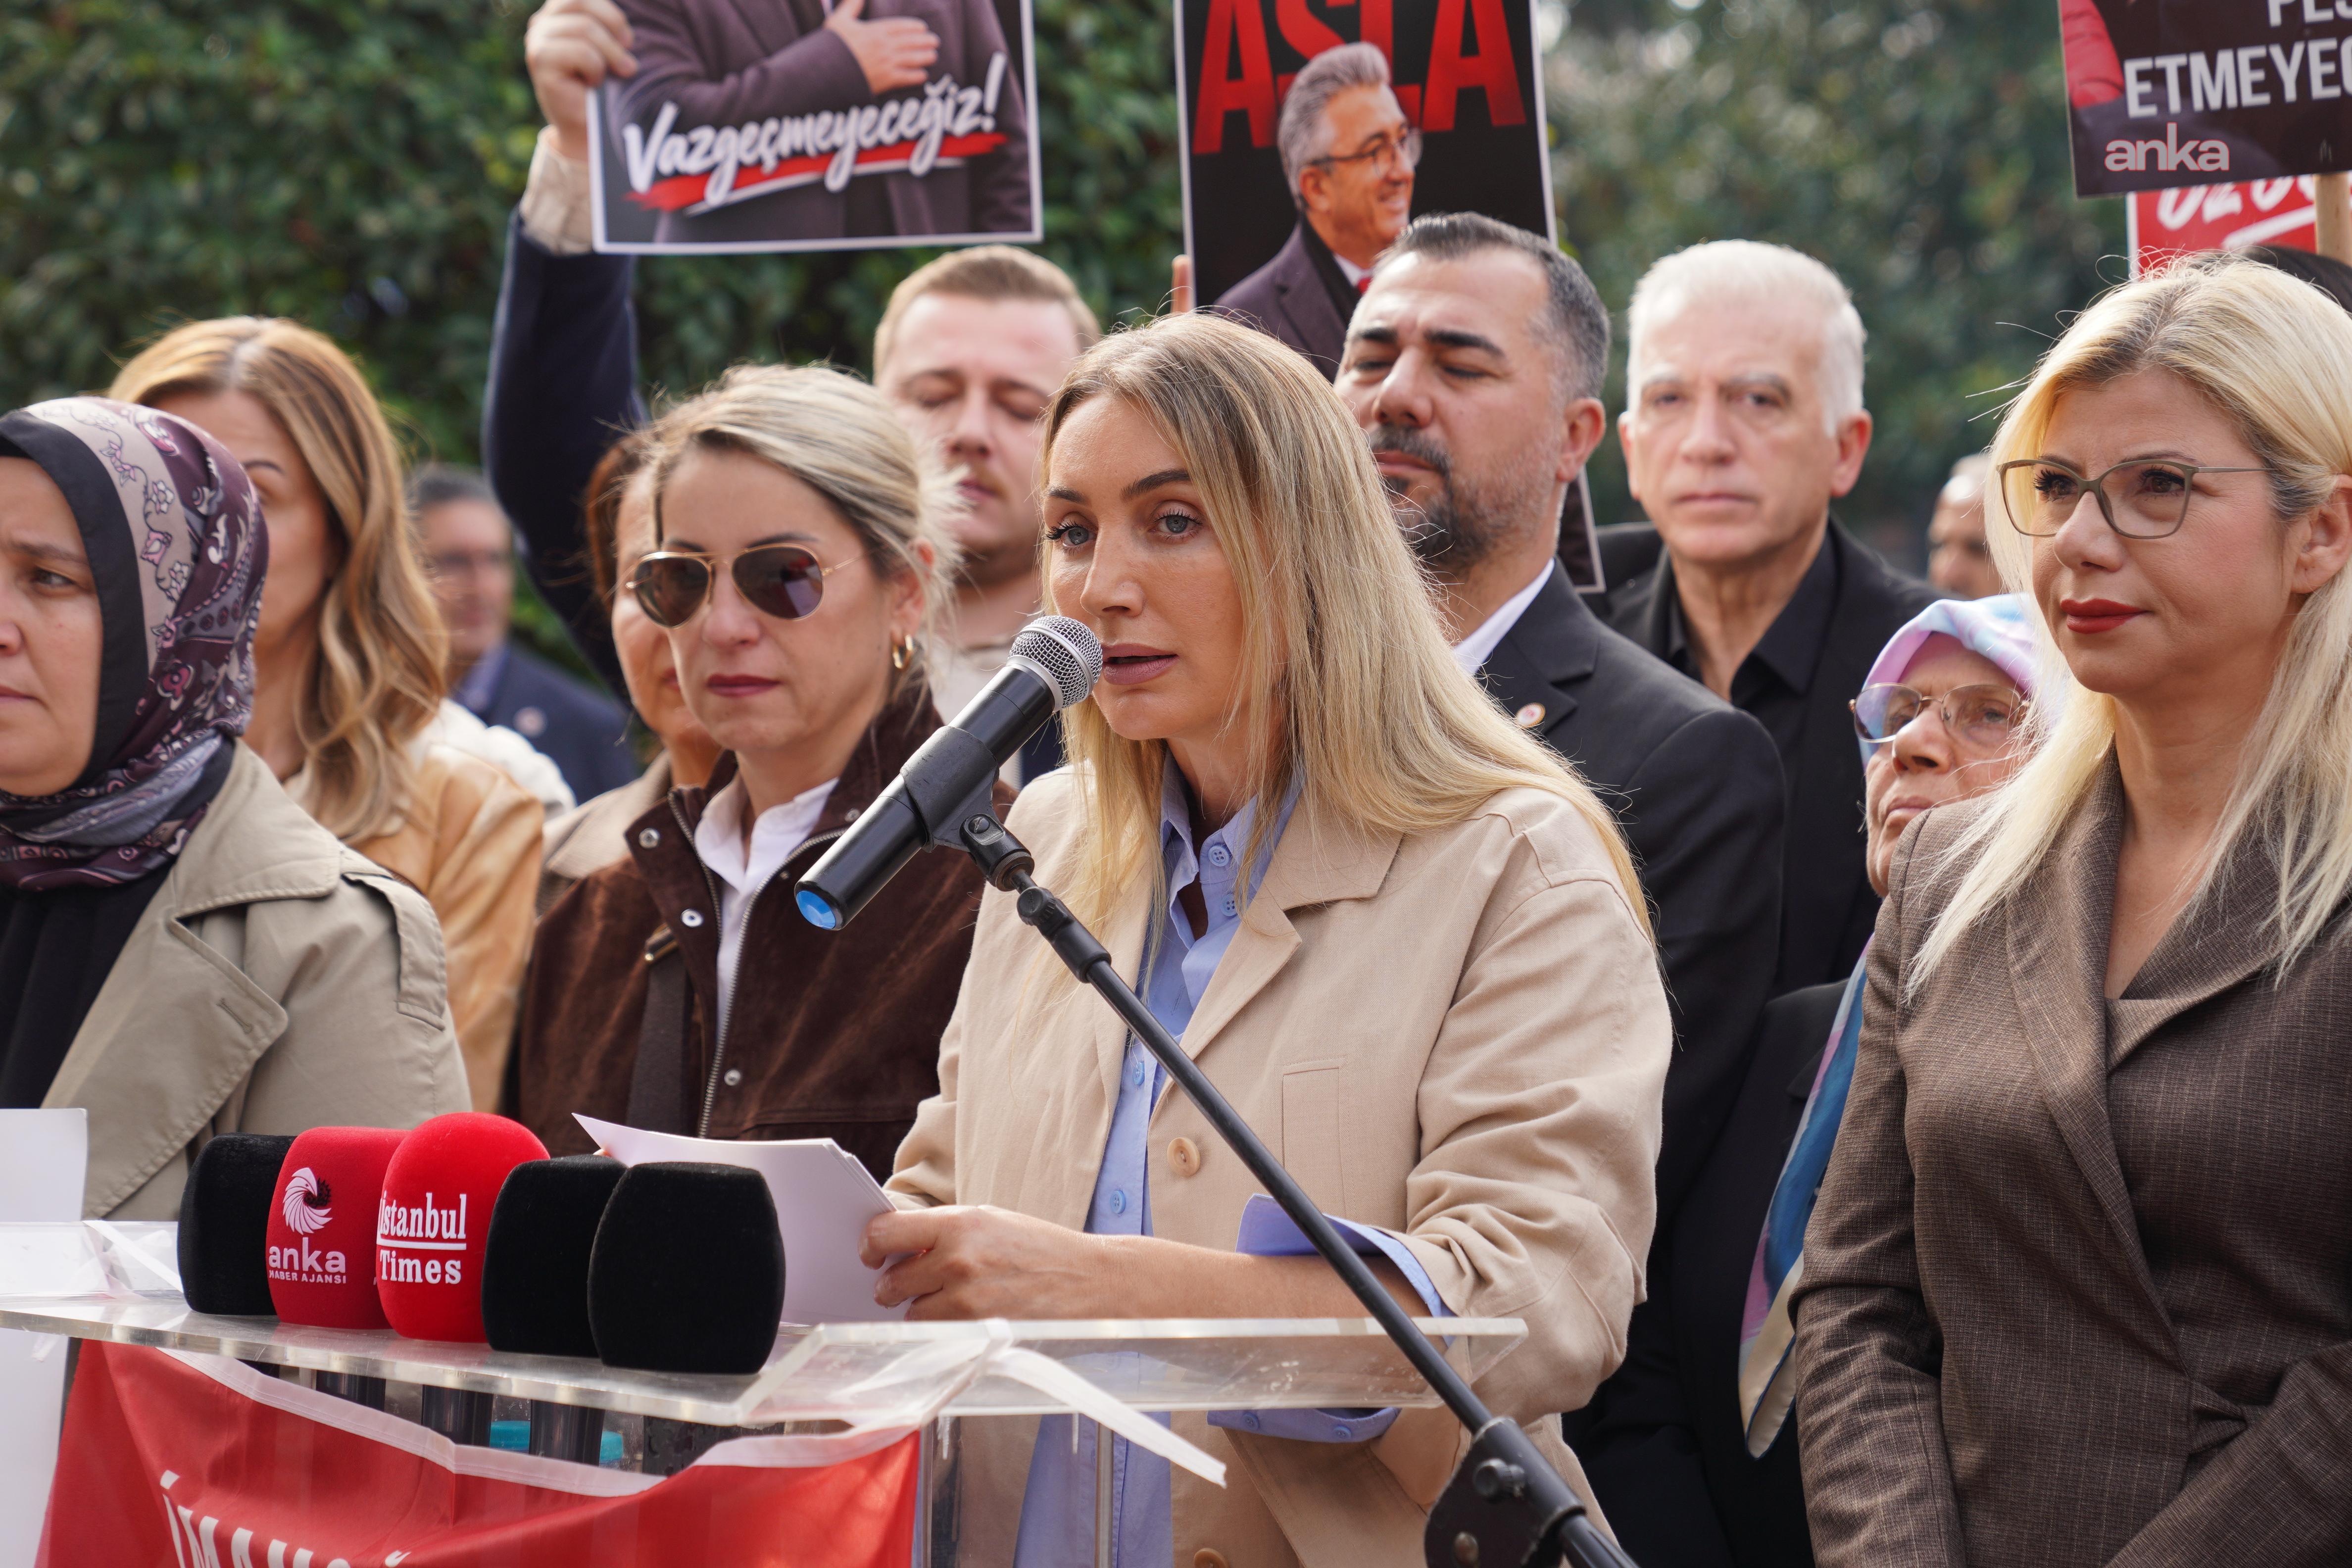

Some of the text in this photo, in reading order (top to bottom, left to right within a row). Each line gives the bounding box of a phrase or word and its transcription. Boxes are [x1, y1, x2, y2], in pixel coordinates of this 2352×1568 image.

[623, 51, 1007, 204] Vazgeçmeyeceğiz!
[269, 1237, 345, 1274] anka
[380, 1249, 461, 1284] Times
[269, 1270, 346, 1284] HABER AJANSI
